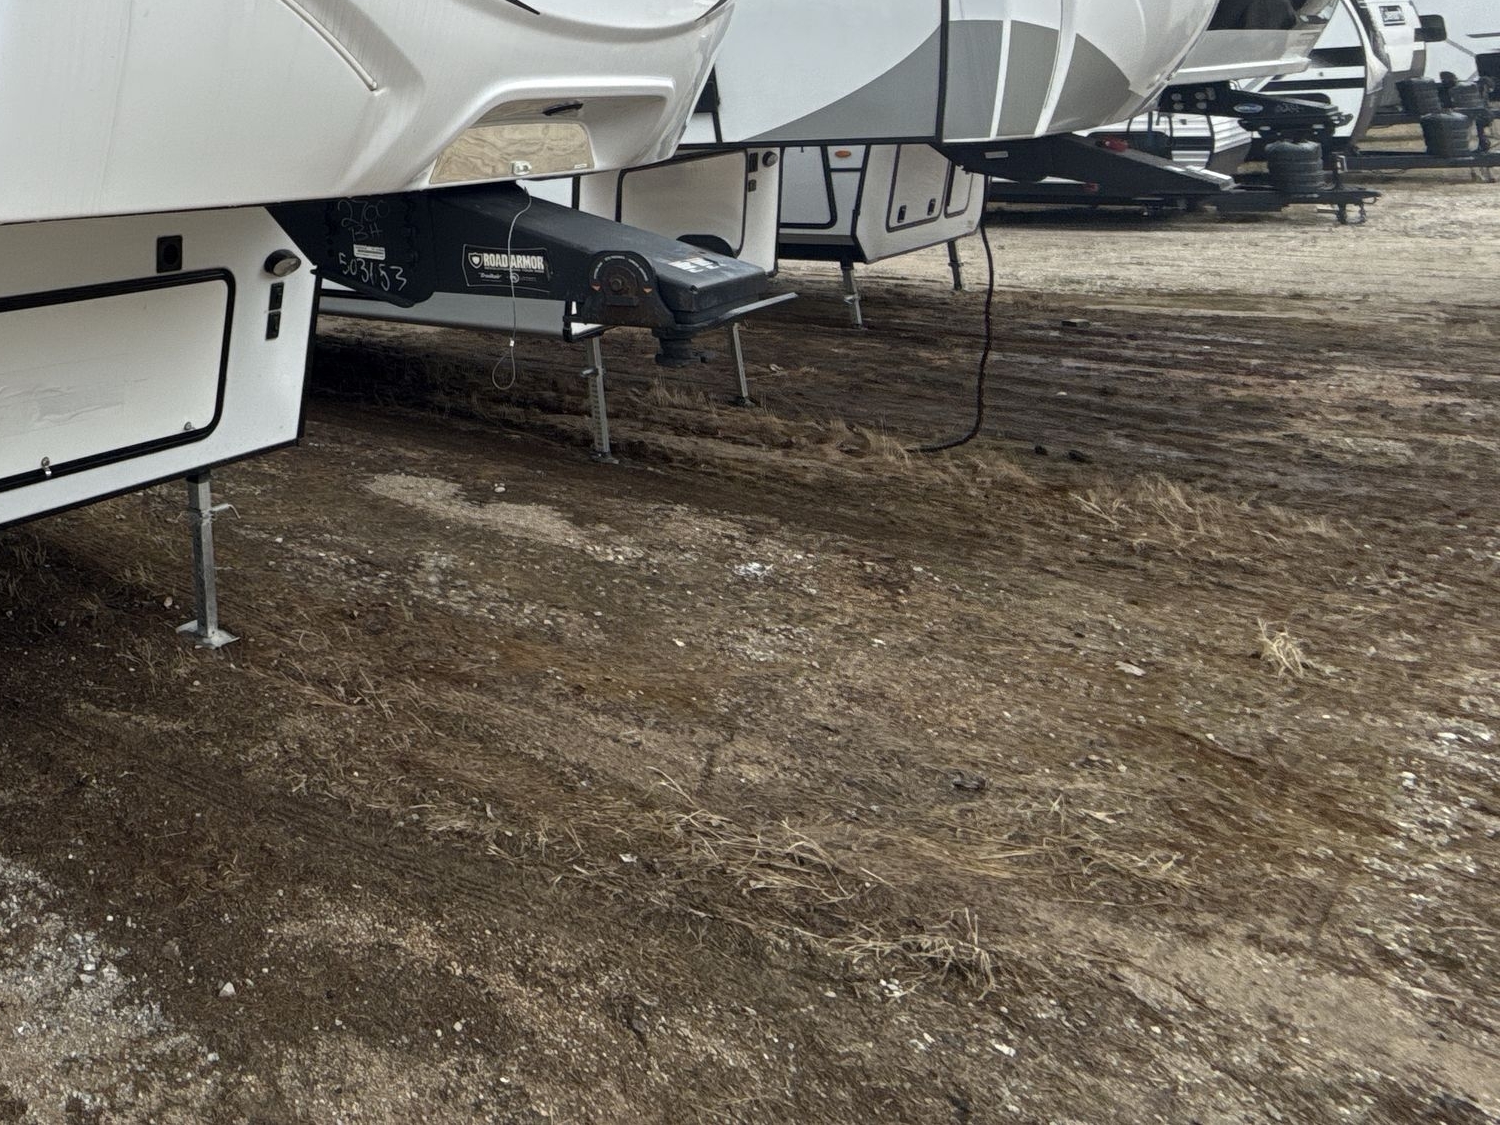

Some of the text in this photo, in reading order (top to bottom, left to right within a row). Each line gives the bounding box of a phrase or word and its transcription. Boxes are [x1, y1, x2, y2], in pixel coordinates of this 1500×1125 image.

[338, 251, 407, 291] 503153
[483, 253, 509, 268] ROAD
[510, 255, 545, 270] ARMOR
